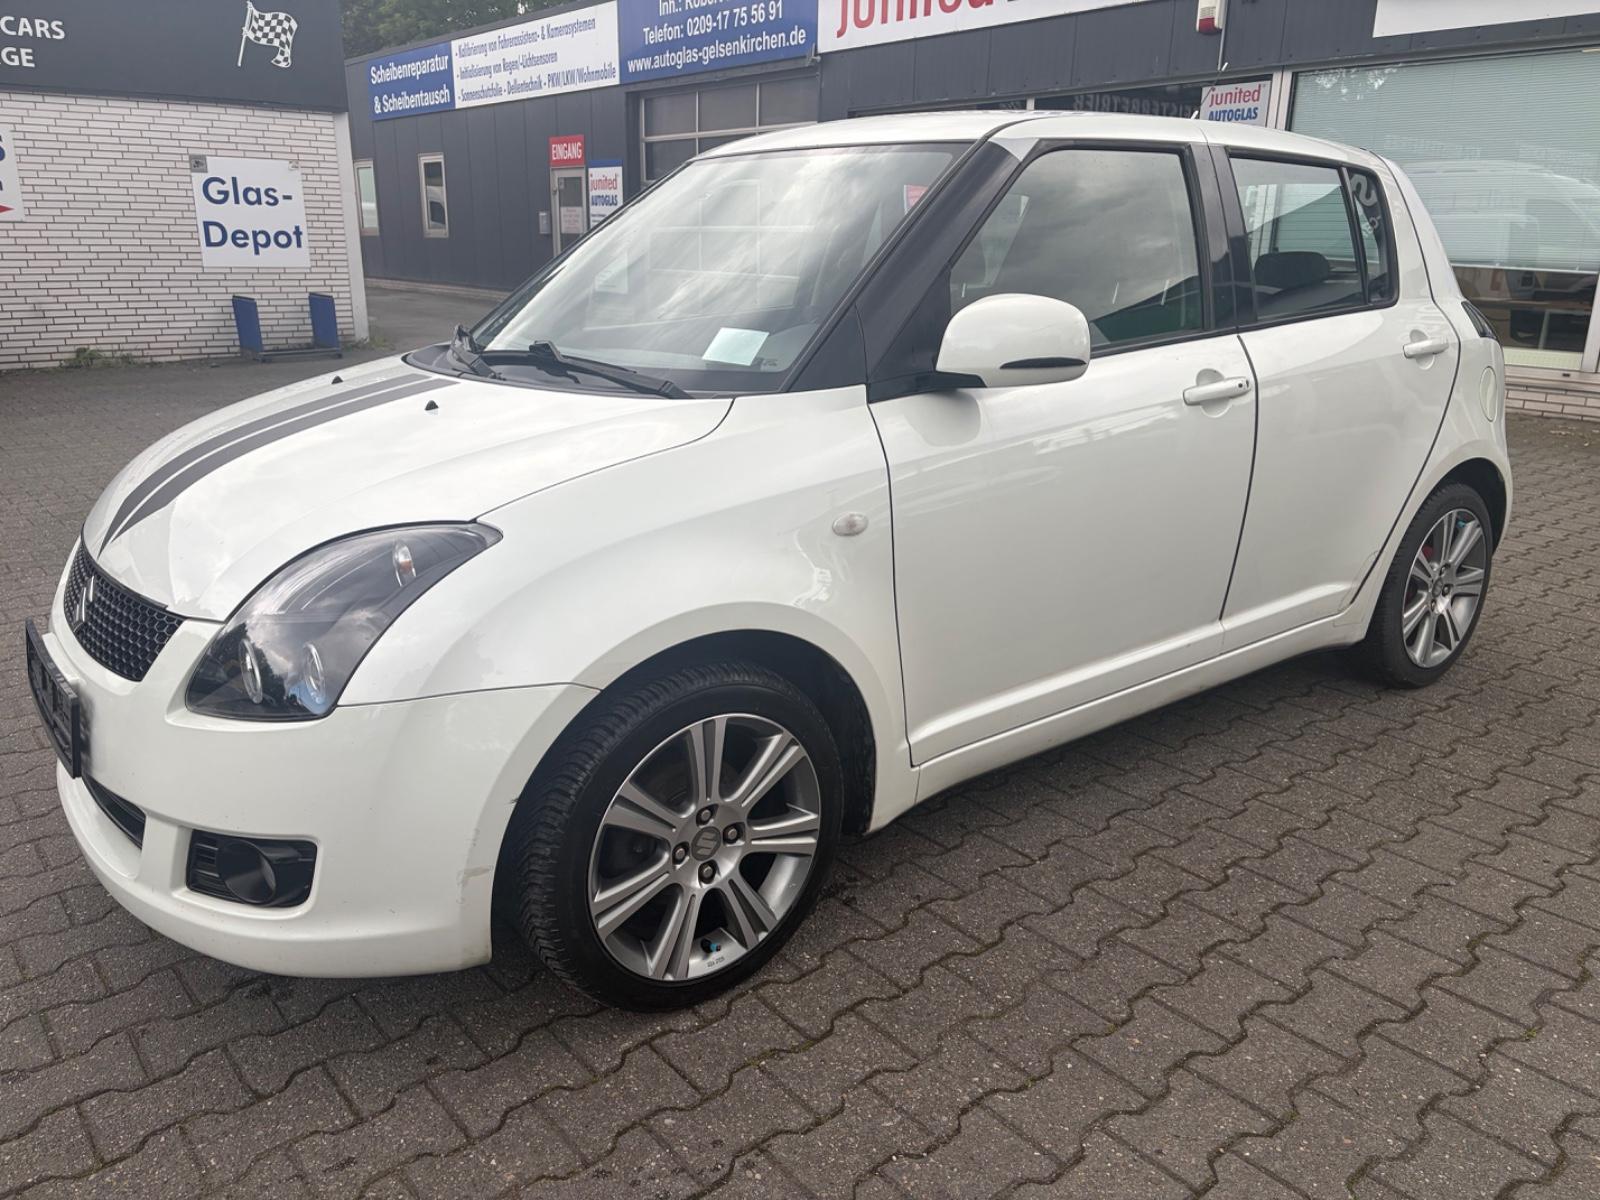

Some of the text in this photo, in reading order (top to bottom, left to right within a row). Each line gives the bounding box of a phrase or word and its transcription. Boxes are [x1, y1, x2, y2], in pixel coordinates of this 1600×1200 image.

[0, 15, 66, 40] CARS
[546, 17, 596, 39] Kamerasystemen
[643, 23, 684, 46] Telefon:
[687, 10, 730, 37] 0209-17
[733, 6, 748, 28] 75
[751, 2, 765, 24] 56
[768, 0, 783, 20] 91
[0, 46, 36, 68] GE
[627, 25, 807, 73] www.autoglas-gelsenkirchen.de
[370, 54, 449, 85] Scheibenreparatur
[374, 84, 450, 114] & Scheibentausch
[1209, 84, 1261, 108] junited
[1208, 107, 1260, 122] AUTOGLAS
[551, 142, 583, 161] EINGANG
[201, 176, 293, 207] Glas-
[589, 171, 618, 192] junited
[591, 194, 619, 207] AUTOGLAS
[202, 220, 303, 256] Depot
